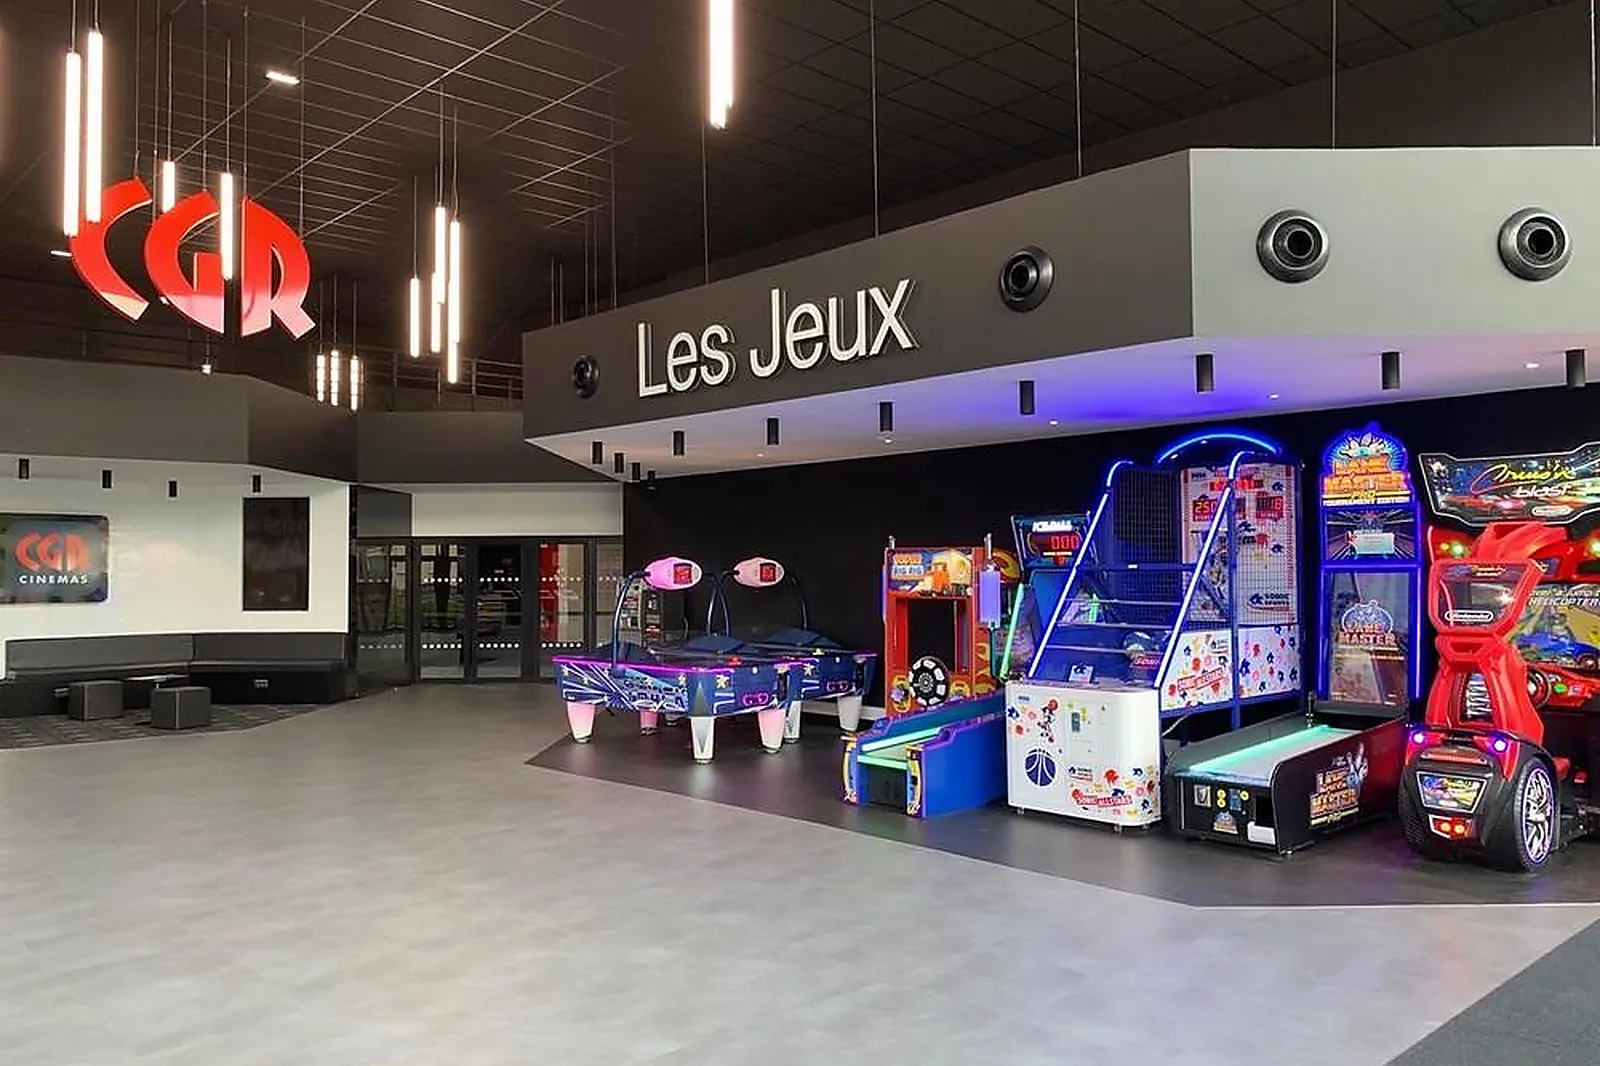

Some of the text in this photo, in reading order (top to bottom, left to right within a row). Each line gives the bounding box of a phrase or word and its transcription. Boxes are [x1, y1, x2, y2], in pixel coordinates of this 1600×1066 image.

[69, 175, 316, 341] CGR
[637, 278, 918, 398] Les Jeux
[19, 574, 89, 585] CINEMAS
[1339, 632, 1397, 646] MASTER
